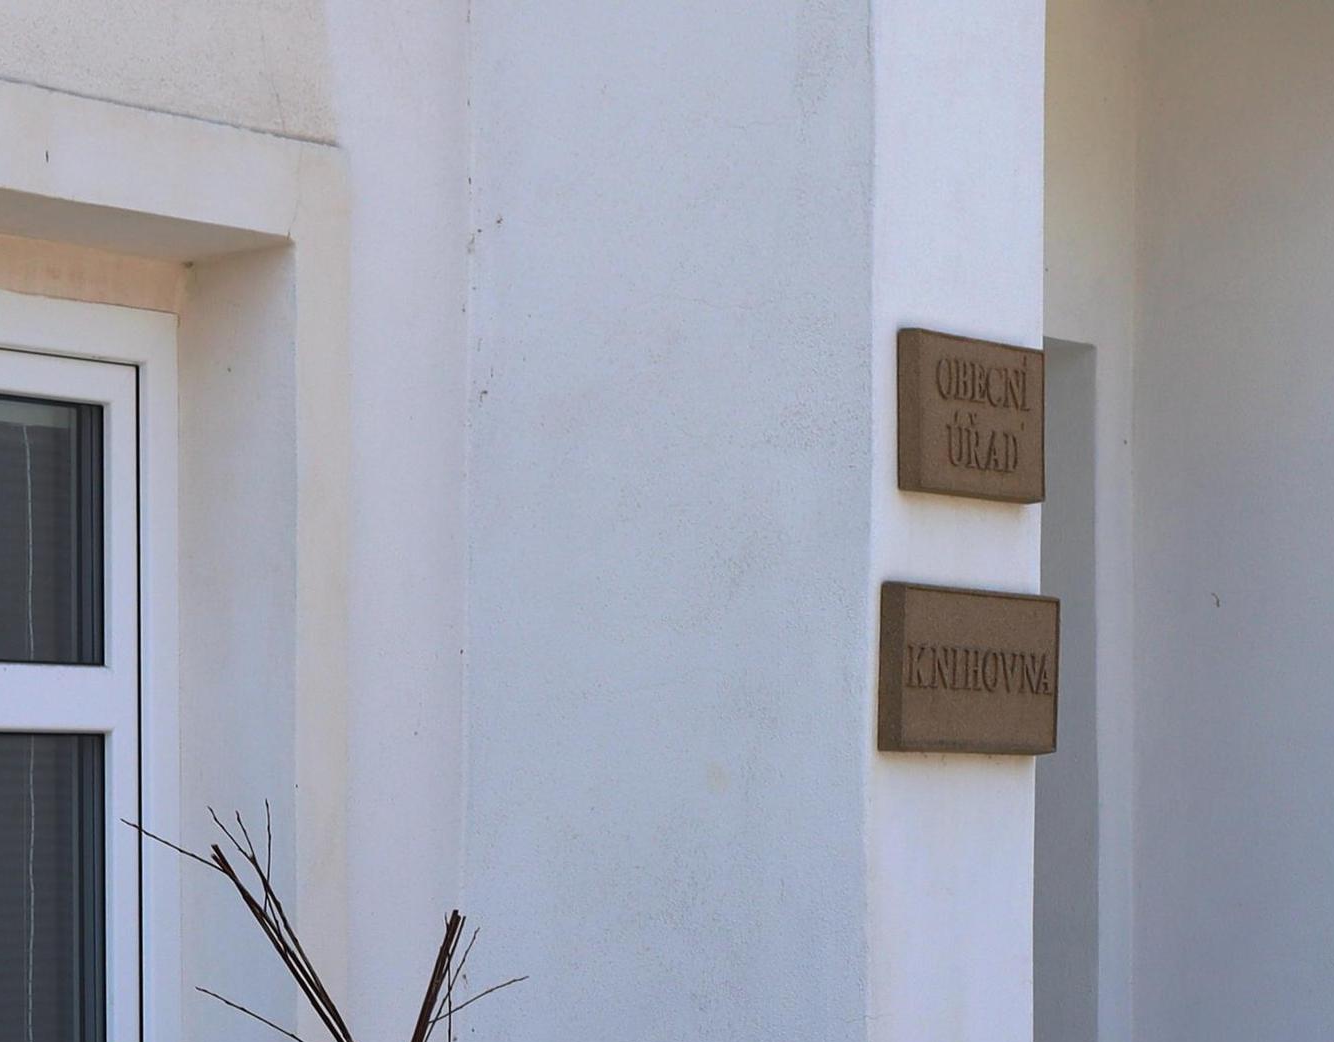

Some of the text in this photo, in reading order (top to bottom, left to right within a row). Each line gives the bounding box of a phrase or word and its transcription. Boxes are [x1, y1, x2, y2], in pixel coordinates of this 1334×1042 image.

[936, 355, 1030, 412] OBECNÍ
[946, 411, 1018, 473] ÚŘAD
[905, 645, 1052, 696] KNIHOVNA
